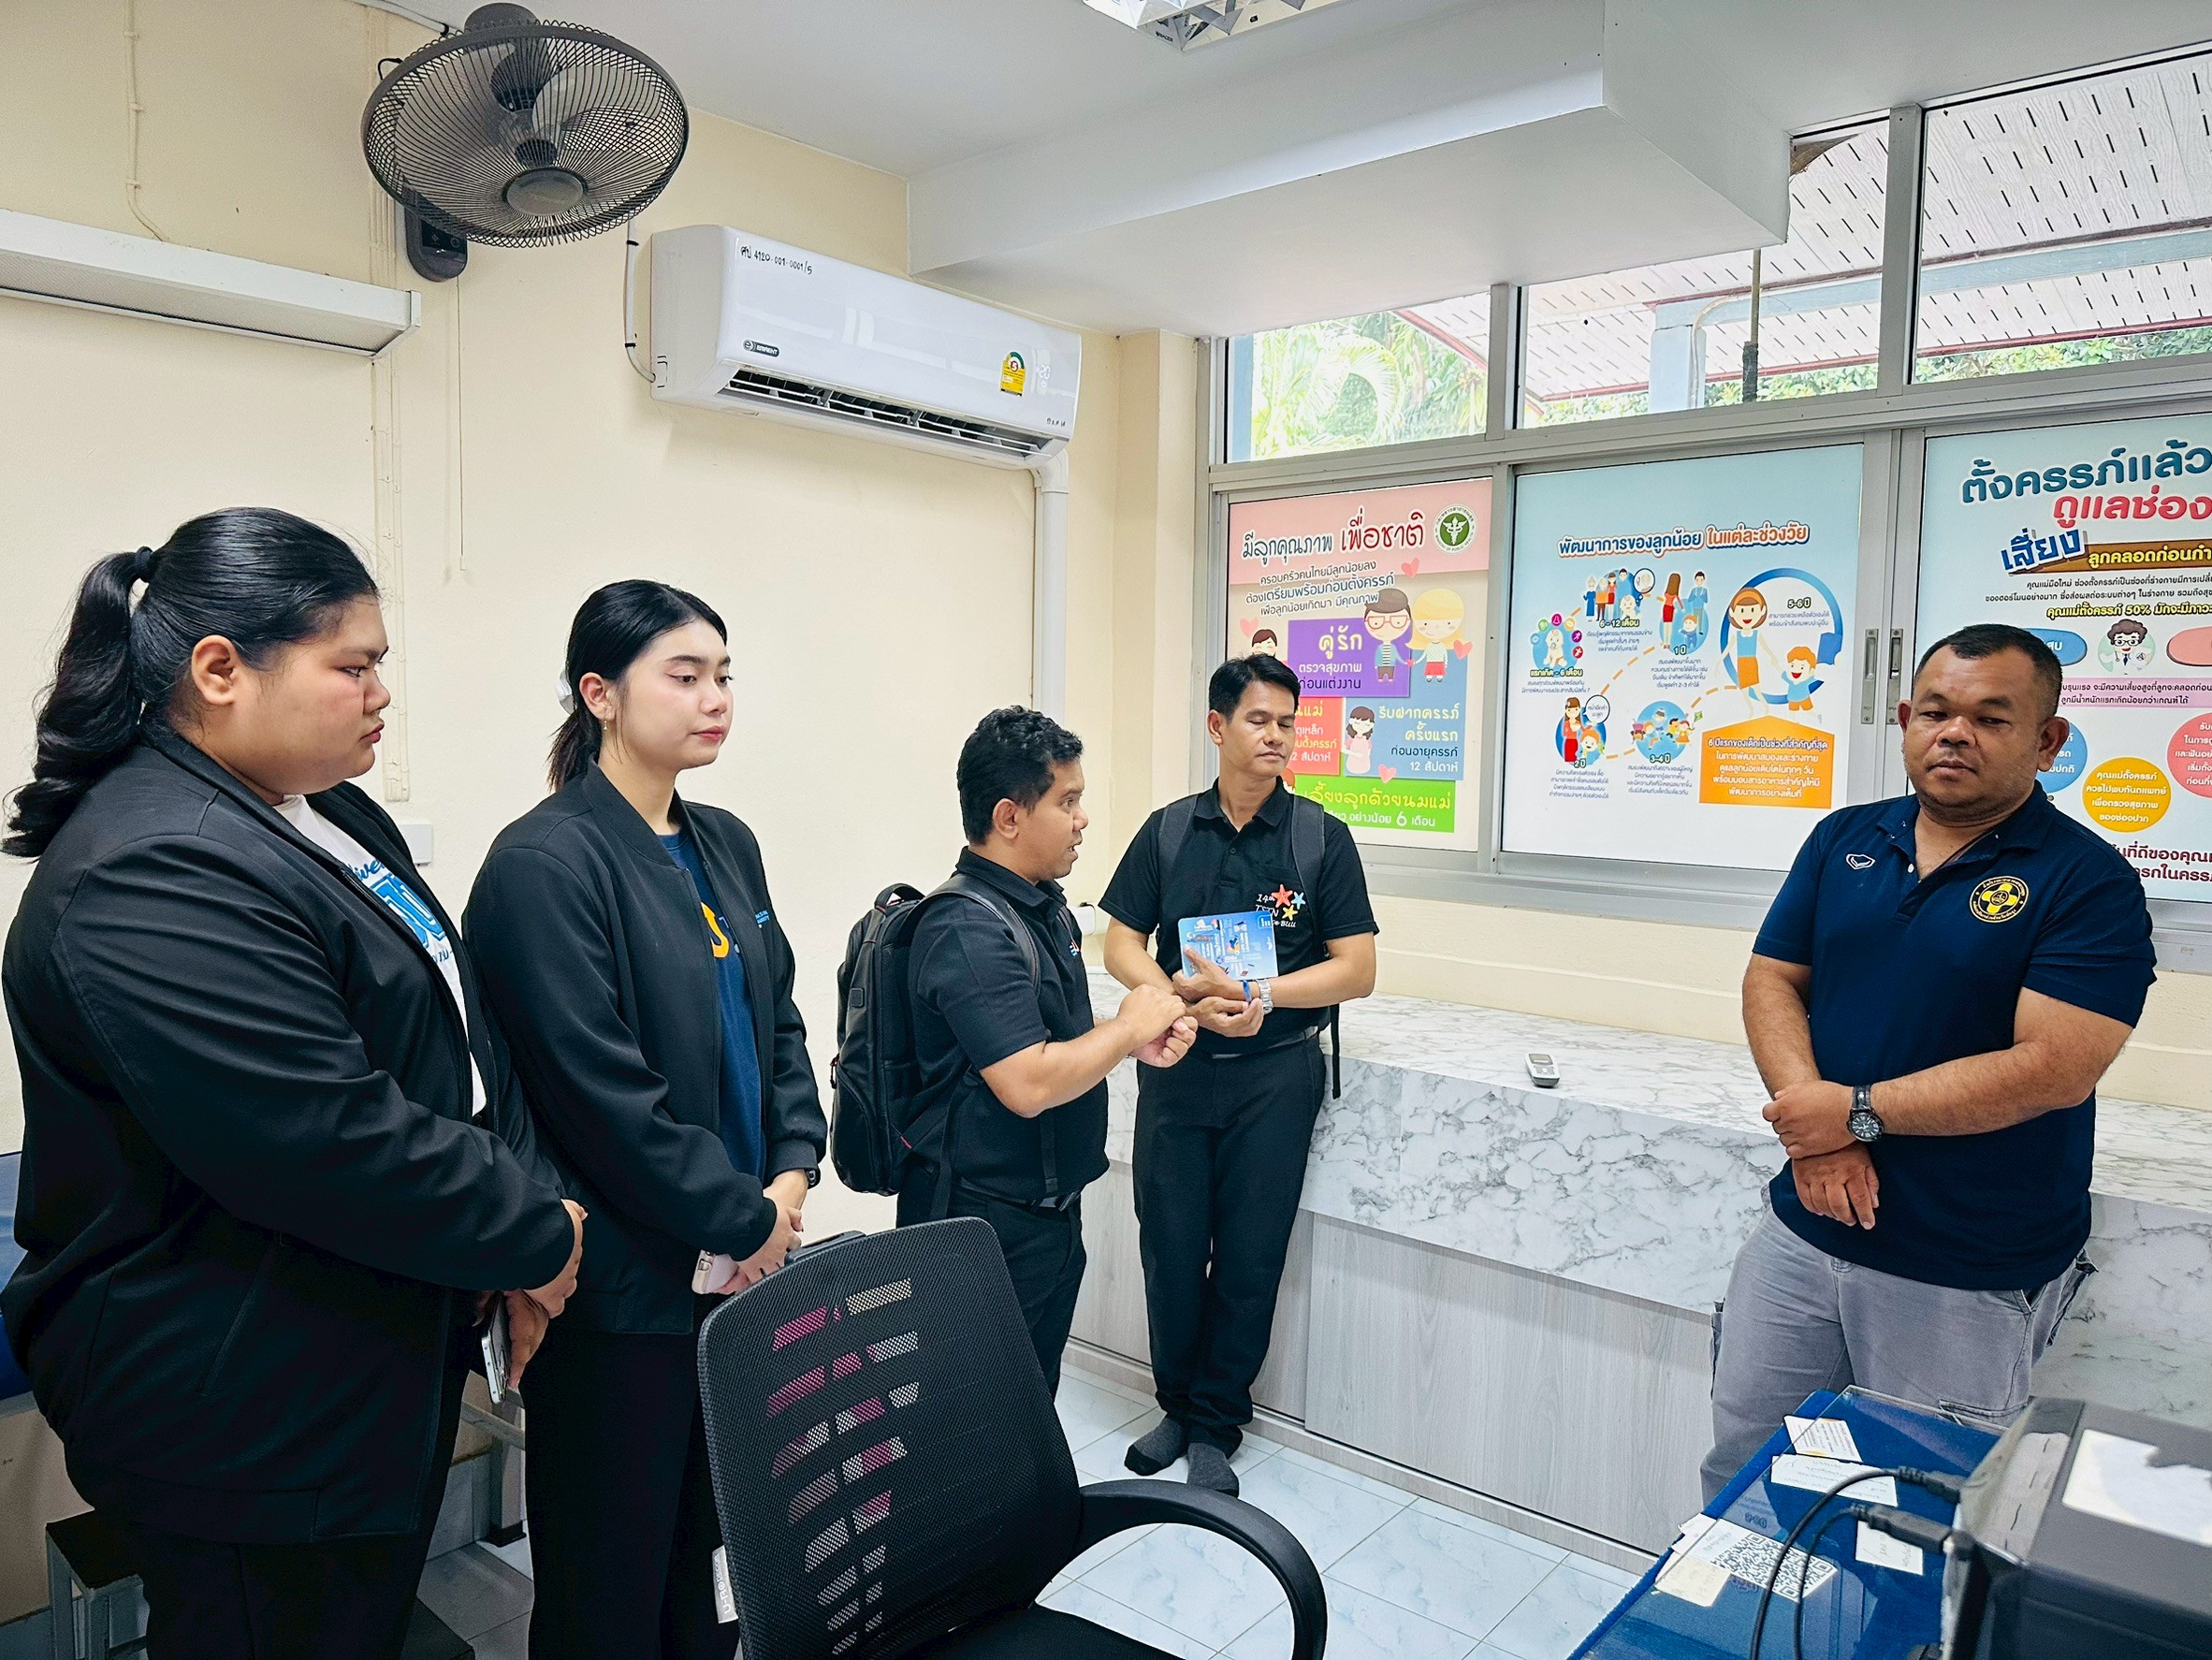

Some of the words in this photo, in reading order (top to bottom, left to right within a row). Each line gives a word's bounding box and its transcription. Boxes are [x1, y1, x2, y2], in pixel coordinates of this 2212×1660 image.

[1962, 439, 2212, 503] ตั้งครรภ์แล้ว
[2053, 484, 2212, 529] ดูแลช่อง
[1243, 531, 1332, 565] มีลูกคุณภาพ
[1341, 507, 1424, 551] เพื่อชาติ
[1559, 529, 1702, 555] พัฒนาการของลูกน้อย
[1708, 522, 1808, 546] ในแต่ละช่วงวัย
[2001, 527, 2081, 570] เสี่ยง
[1260, 561, 1376, 585] ครอบครัวคนไทยมีลูกน้อยลง
[2027, 578, 2072, 590] คุณแม่มือใหม่
[2074, 572, 2212, 588] ช่วงตั้งครรภ์เป็นช่วงที่ร่างกายมีการเปลี่
[1245, 572, 1394, 604] ต้องเตรียมพร้อมก่อนตั้งครรภ์
[2138, 589, 2175, 597] ในร่างกาย
[1260, 599, 1332, 618] เพื่อลูกน้อยเกิดมา
[1336, 593, 1378, 608] มีคุณภาพ
[2046, 602, 2121, 619] คุณแม่ตั้งครรภ์
[2125, 604, 2150, 616] 50%
[1318, 625, 1362, 660] คู่รัก
[1299, 663, 1362, 677] ตรวจสุขภาพ
[1299, 676, 1361, 690] ก่อนแต่งงาน
[1404, 721, 1458, 742] ครั้งแรก
[1390, 745, 1458, 759] ก่อนอายุครรภ์
[1410, 761, 1420, 771] 12
[1424, 761, 1459, 773] สัปดาห์
[2097, 769, 2158, 780] คุณแม่ตั้งครรภ์
[2092, 796, 2159, 809] เพื่อตรวจสุขภาพ
[1396, 811, 1407, 827] 6
[1411, 815, 1435, 827] เดือน
[2100, 812, 2149, 823] ของช่องปาก
